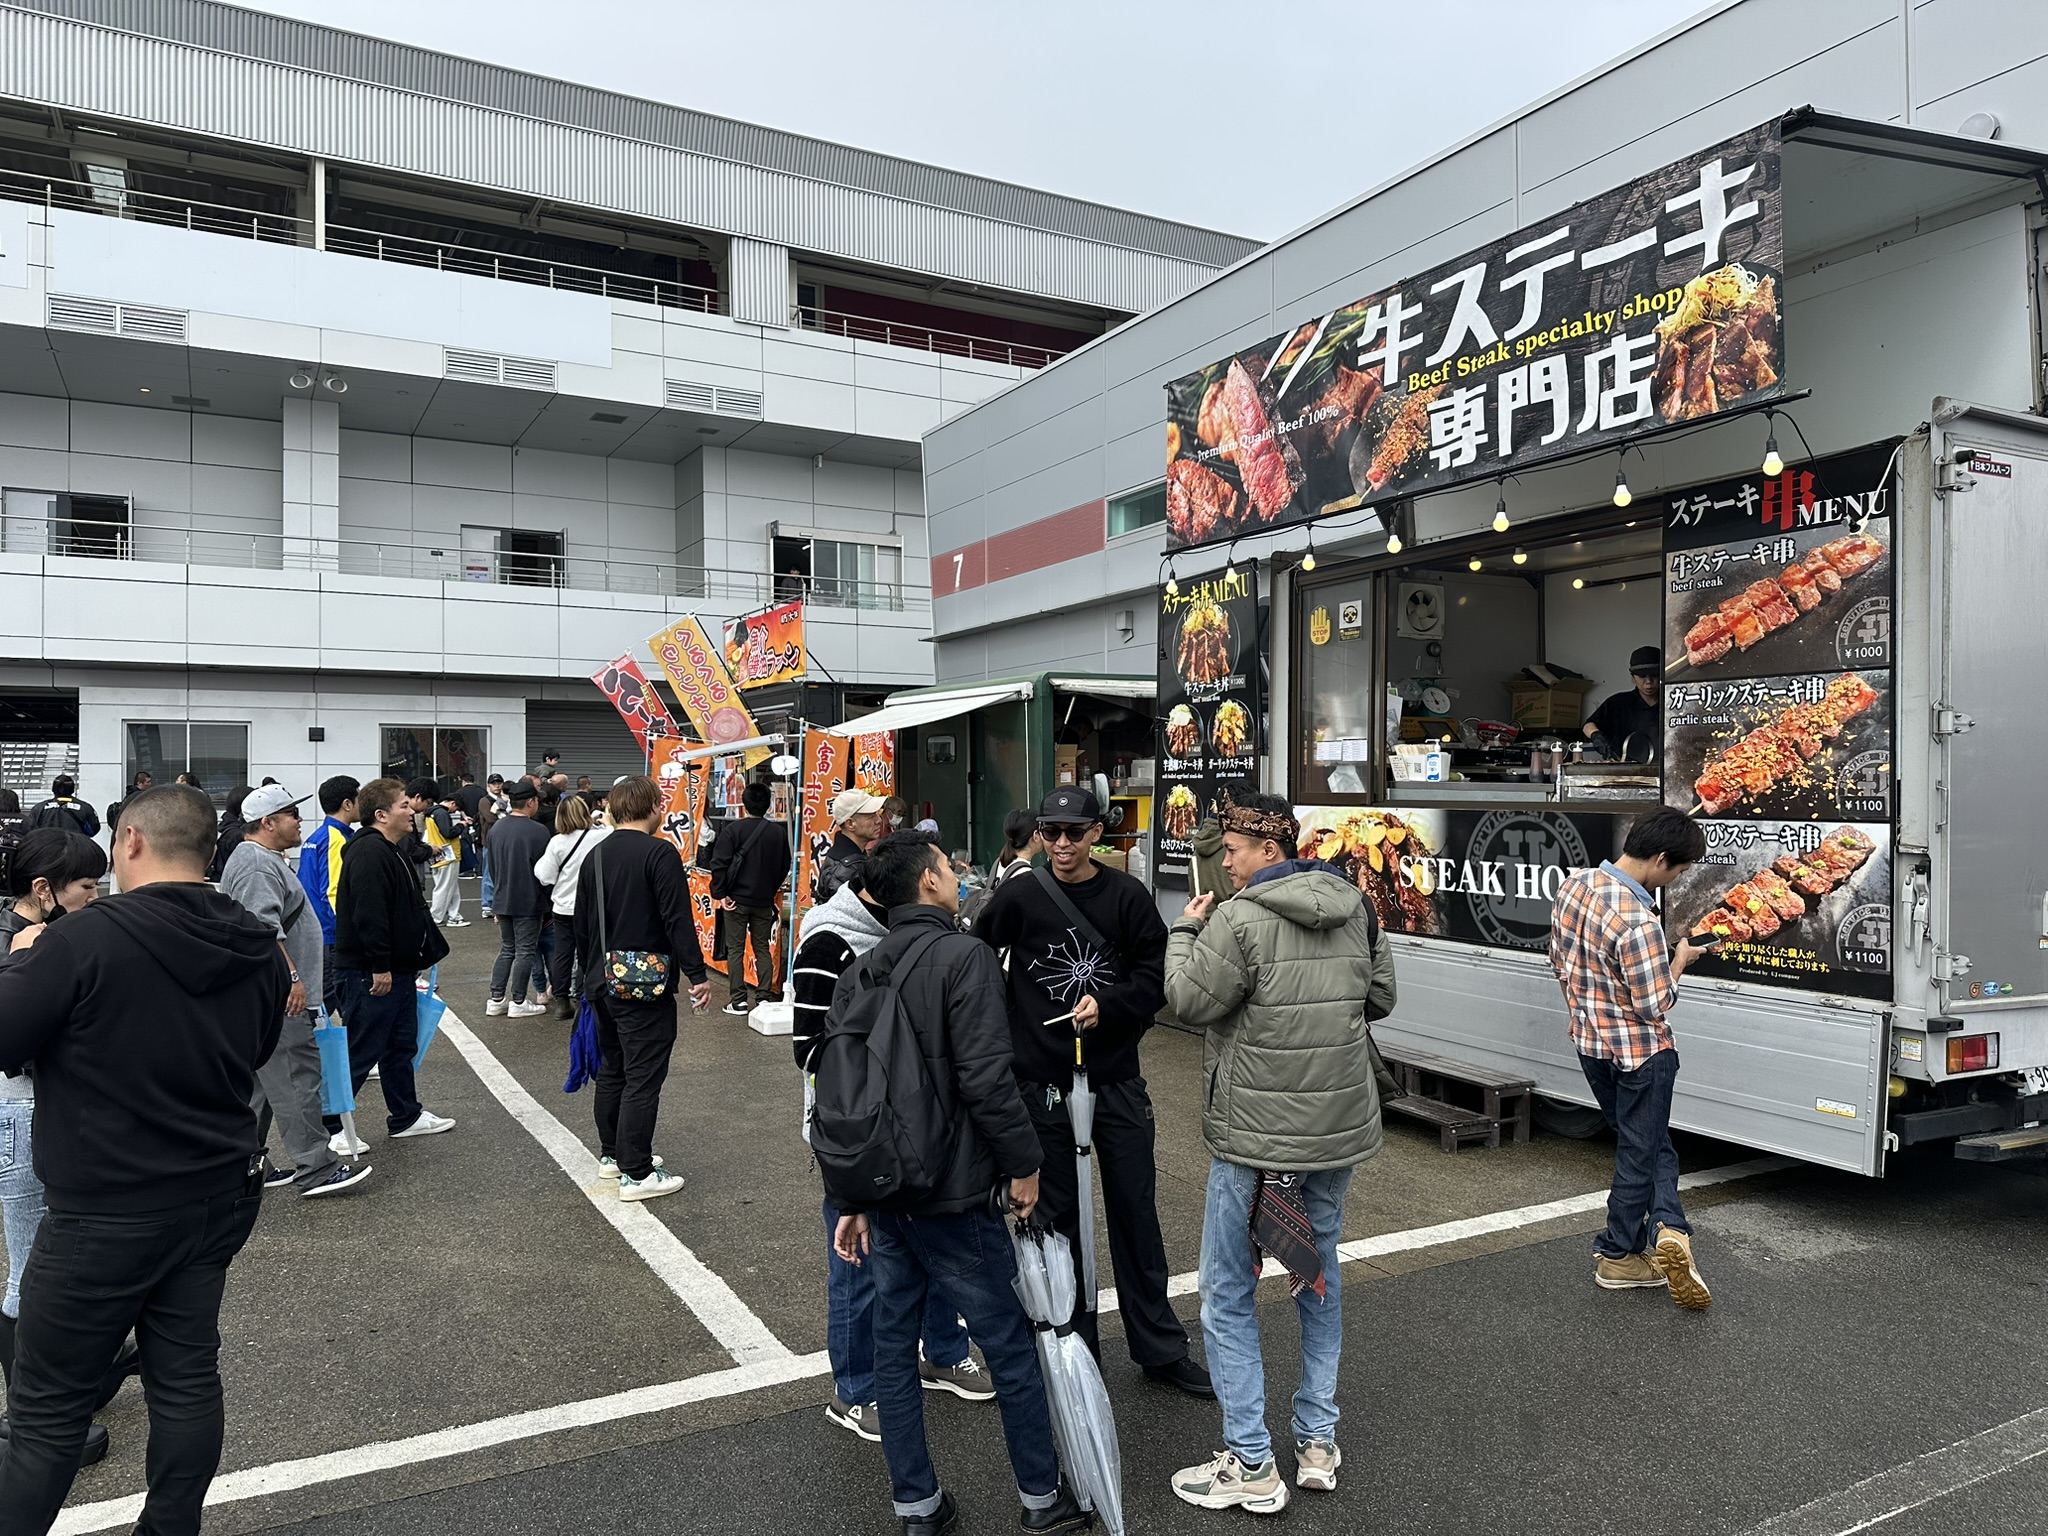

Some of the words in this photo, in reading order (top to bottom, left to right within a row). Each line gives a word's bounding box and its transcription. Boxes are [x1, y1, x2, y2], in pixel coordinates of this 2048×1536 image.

[1357, 158, 1758, 388] 牛ステーキ
[1407, 360, 1451, 392] Beef
[1457, 341, 1511, 377] Steak
[1515, 309, 1616, 358] specialty
[1621, 287, 1682, 326] shop
[1427, 333, 1659, 471] 専門店
[1197, 441, 1238, 462] Premium
[1240, 428, 1275, 449] Quality
[1278, 415, 1306, 434] Beef
[1308, 405, 1339, 425] 100%
[1669, 470, 1815, 530] ステーキ串
[1797, 489, 1888, 527] MENU
[953, 552, 964, 588] 7
[1672, 538, 1795, 579] 牛ステーキ串
[1672, 580, 1693, 592] beef
[1696, 576, 1723, 589] steak
[1845, 646, 1882, 658] ¥1000
[1670, 676, 1825, 710] ガーリックステーキ串
[1669, 715, 1699, 727] garlic
[1702, 713, 1730, 725] steak
[1845, 800, 1882, 811] ¥1100
[1700, 823, 1821, 853] びステーキ串
[1399, 854, 1506, 897] STEAK
[1515, 863, 1573, 902] HO
[1840, 907, 1871, 940] service
[1845, 950, 1883, 964] ¥1100
